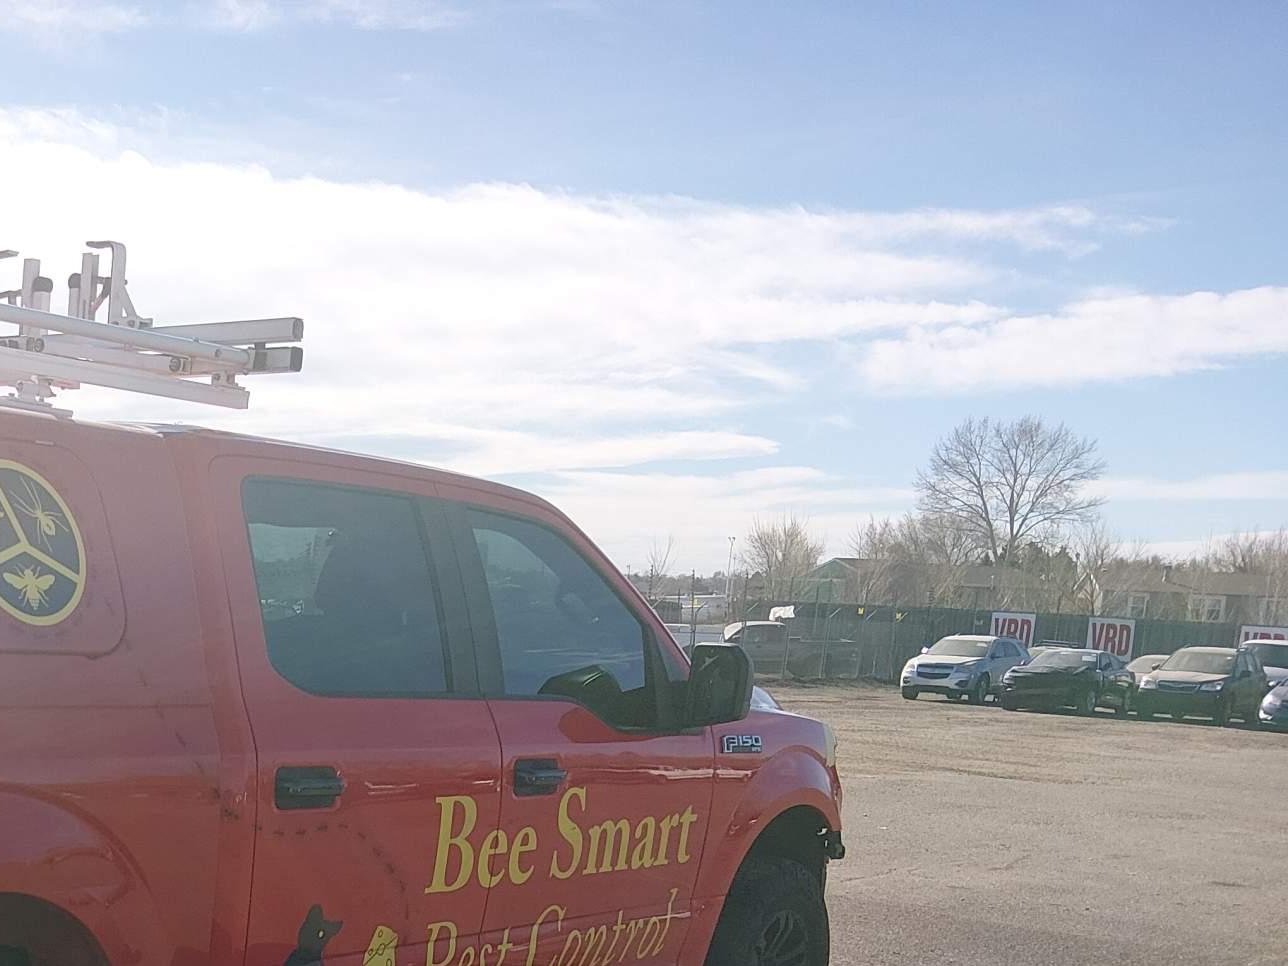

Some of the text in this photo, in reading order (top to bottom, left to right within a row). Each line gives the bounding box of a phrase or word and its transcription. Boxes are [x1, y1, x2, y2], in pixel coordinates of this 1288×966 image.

[1092, 622, 1131, 656] VRD
[424, 786, 699, 895] Bee Smart
